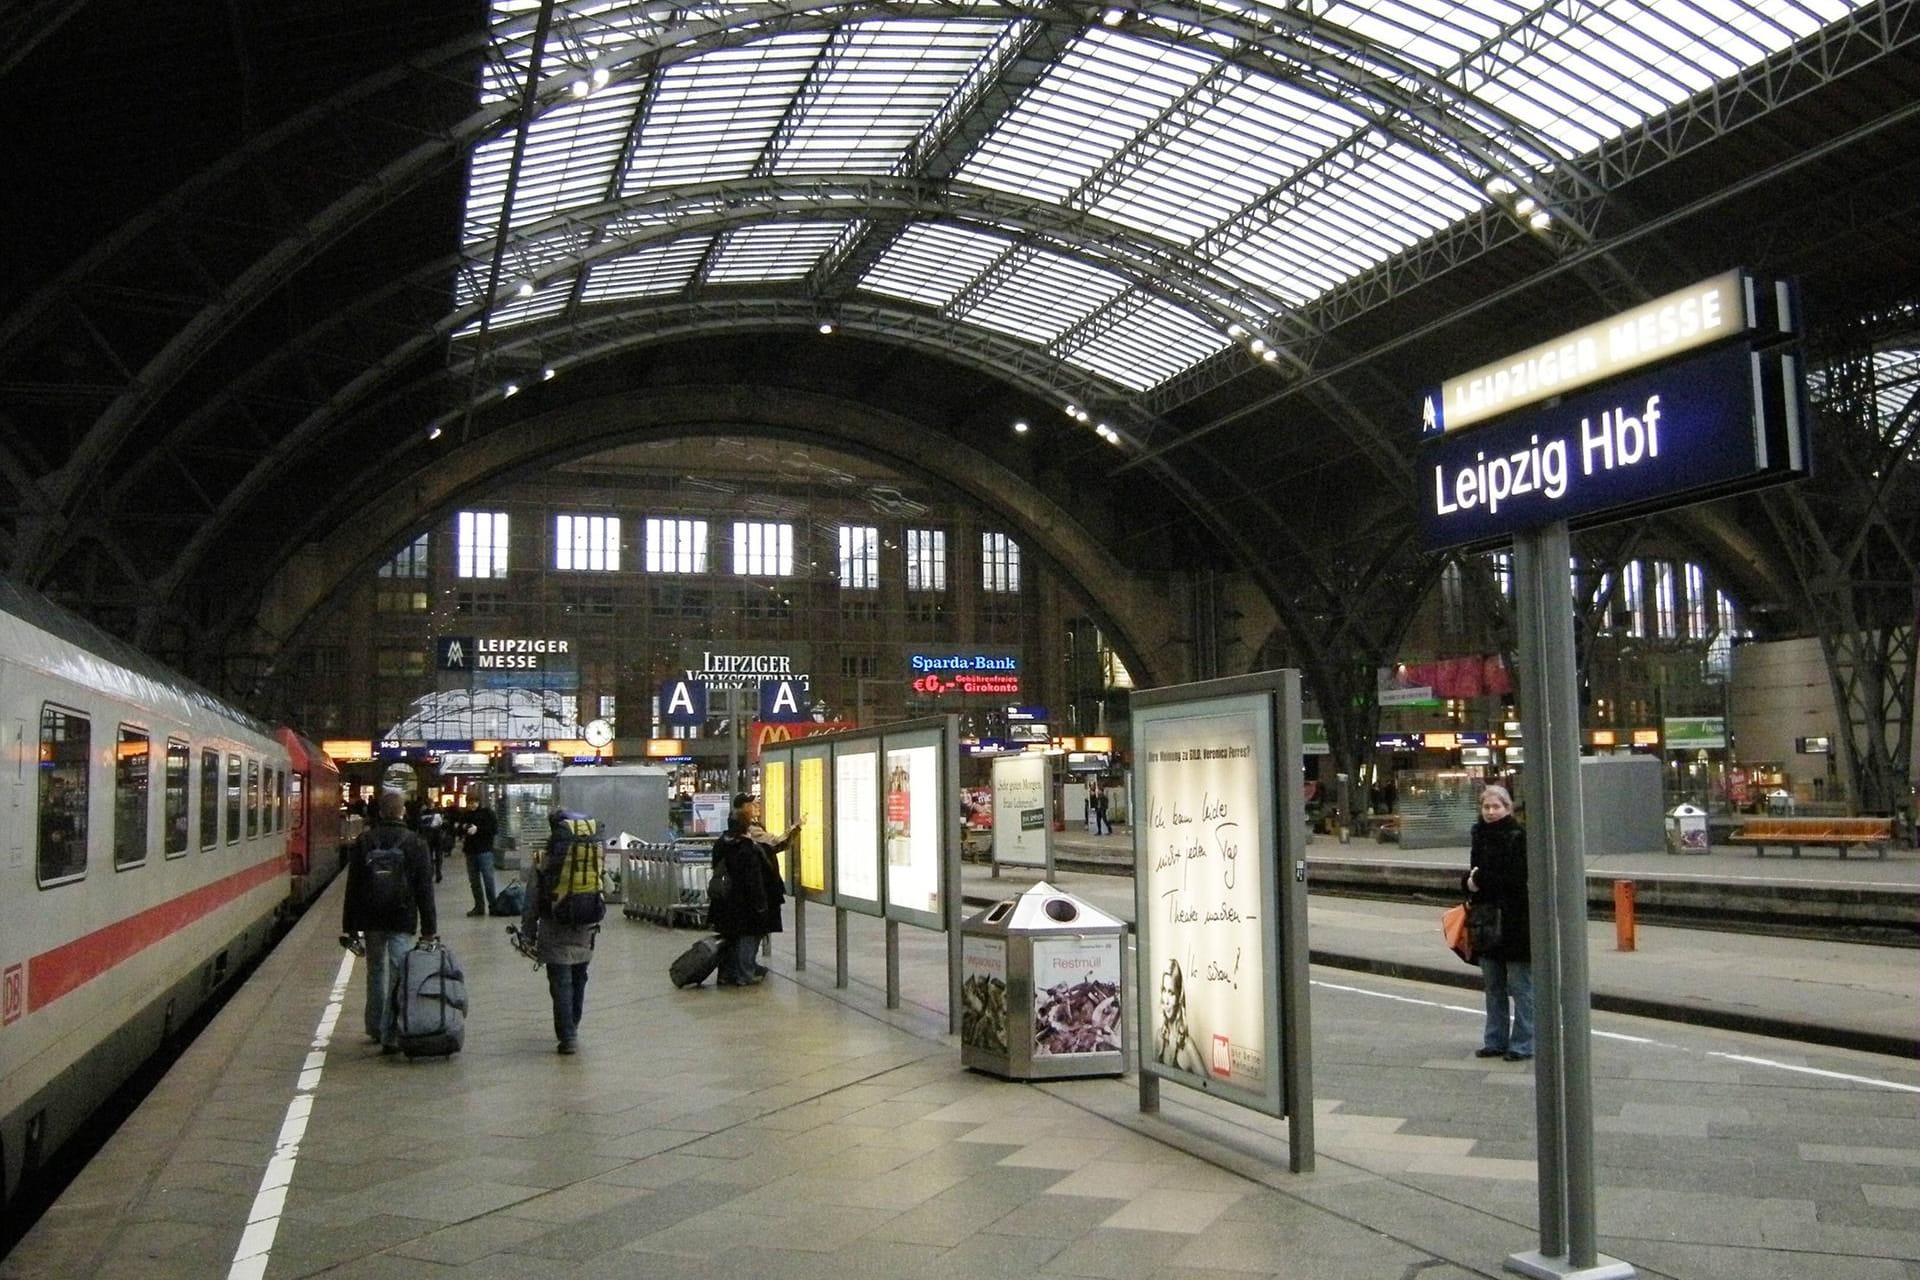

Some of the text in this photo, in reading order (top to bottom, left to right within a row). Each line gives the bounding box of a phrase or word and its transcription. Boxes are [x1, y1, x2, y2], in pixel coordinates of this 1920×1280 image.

[1455, 289, 1721, 414] LEIPZIGER MESSE
[1435, 394, 1661, 517] Leipzig Hbf
[478, 639, 569, 653] LEIPZIGER
[478, 655, 538, 668] MESSE
[703, 651, 791, 673] LEIPZIGER
[911, 655, 1016, 672] Sparda-Bank
[667, 681, 695, 715] A
[771, 681, 798, 714] A
[963, 682, 1018, 692] Girokonto
[1215, 822, 1239, 890] Tag
[1052, 957, 1102, 969] Restmüll
[5, 970, 20, 1017] DB
